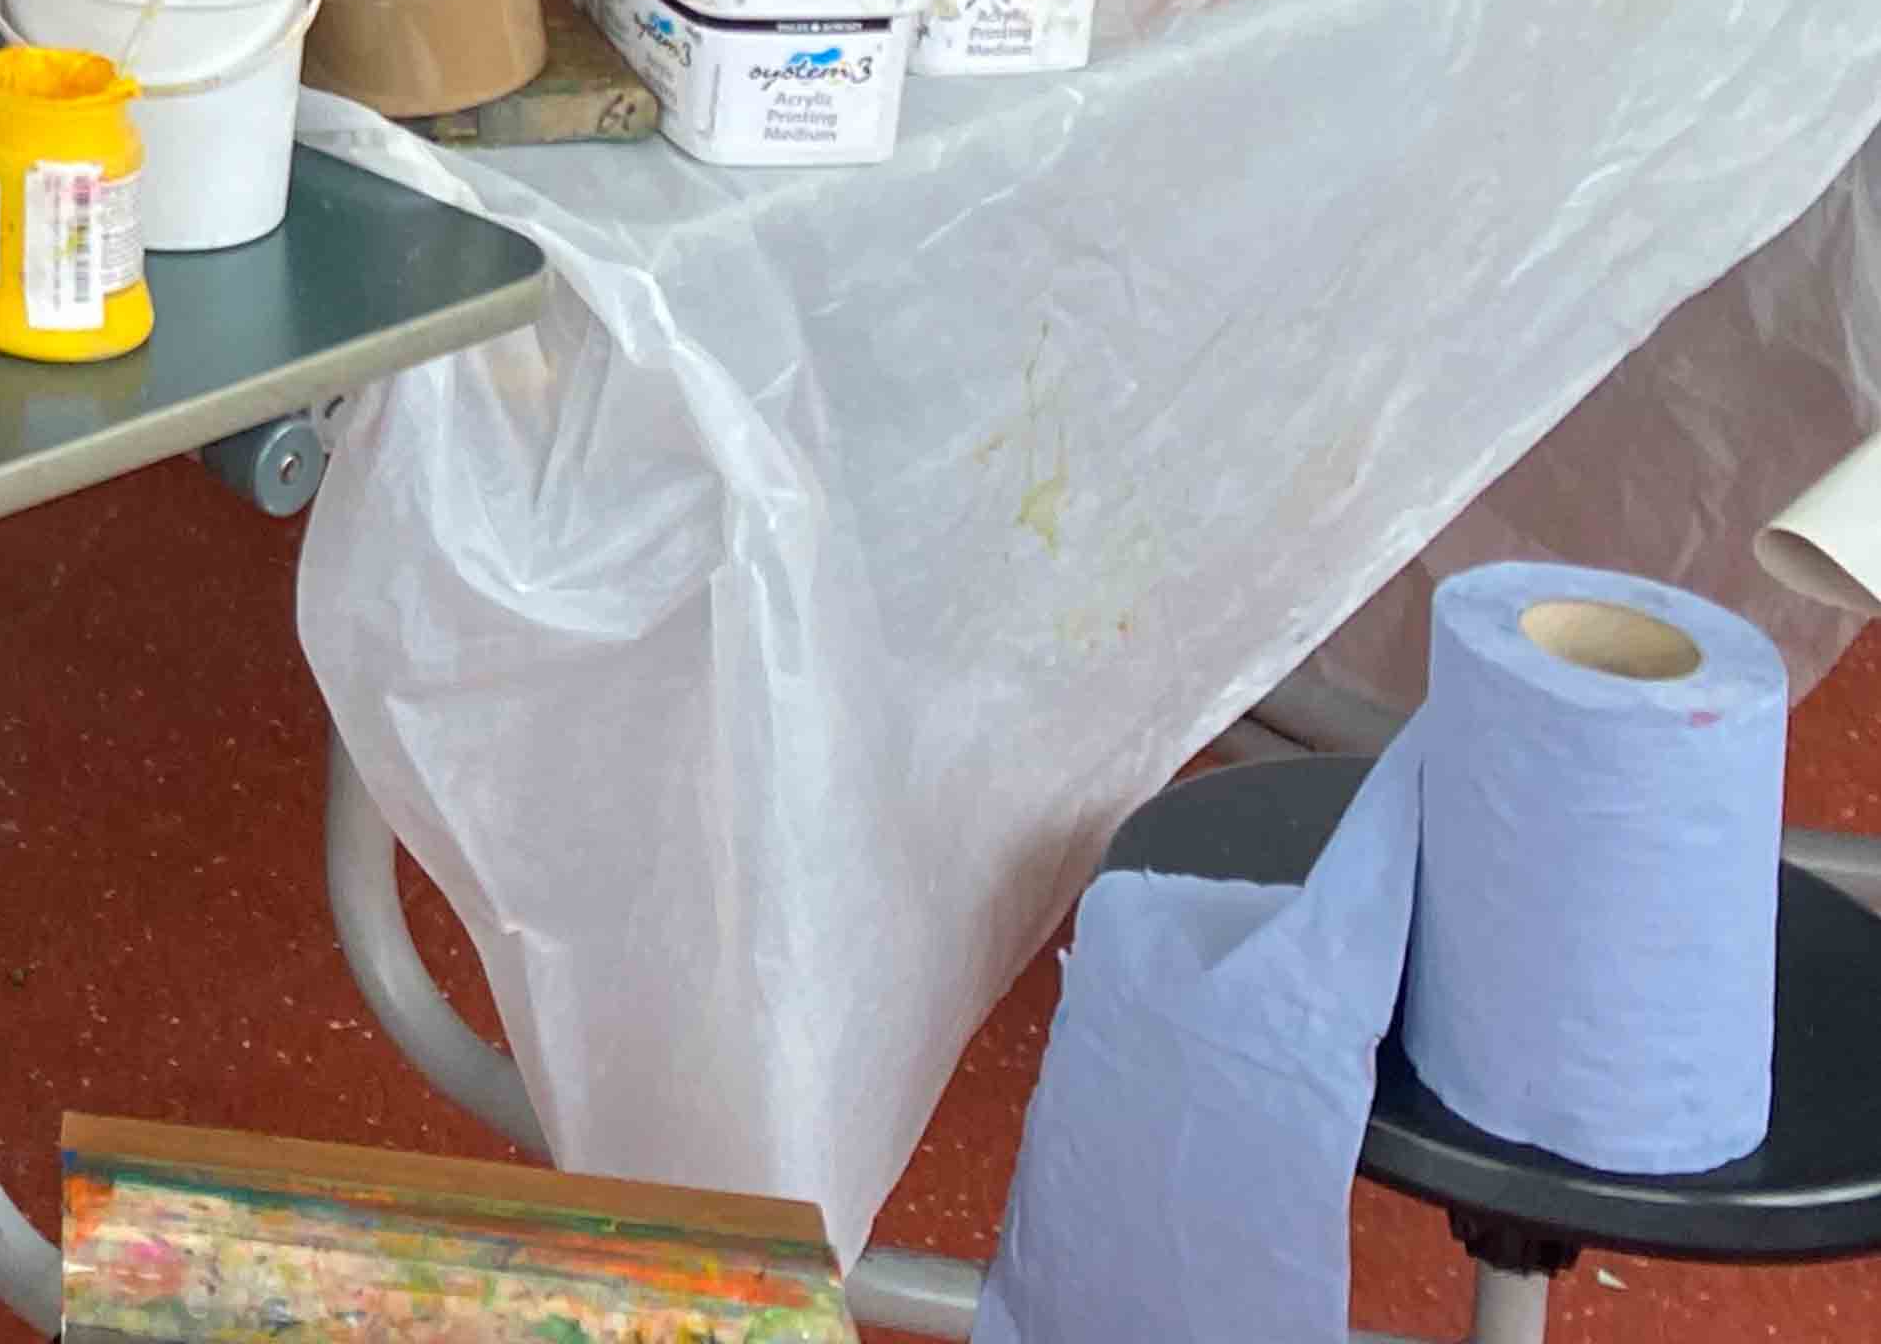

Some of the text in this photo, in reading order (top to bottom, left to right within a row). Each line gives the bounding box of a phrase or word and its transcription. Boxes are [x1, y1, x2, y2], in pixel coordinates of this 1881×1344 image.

[748, 55, 874, 92] system3
[774, 91, 833, 108] Acrylic
[766, 109, 837, 126] Printing
[763, 127, 837, 143] Medium
